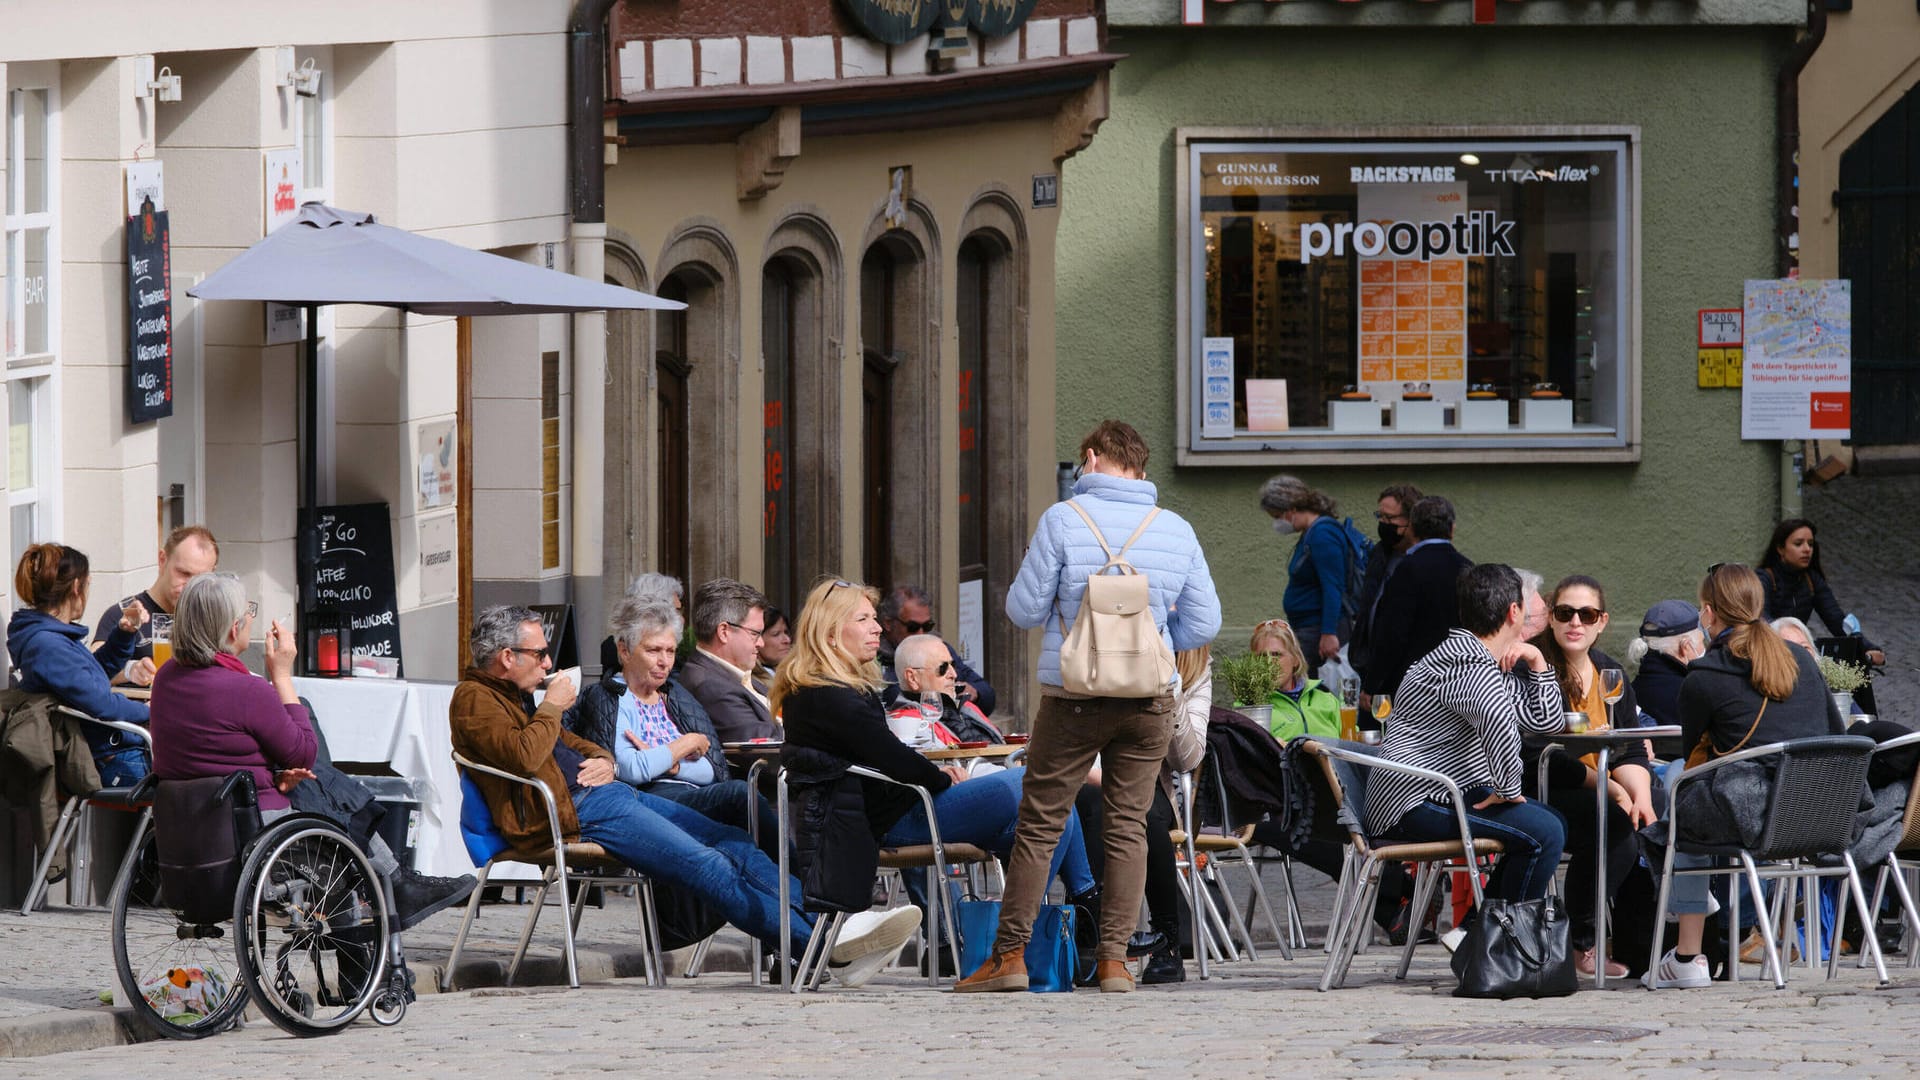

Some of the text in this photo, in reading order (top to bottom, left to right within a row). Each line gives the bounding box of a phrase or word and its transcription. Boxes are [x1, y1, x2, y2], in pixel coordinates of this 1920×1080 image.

[1217, 163, 1278, 173] GUNNAR
[1350, 166, 1455, 183] BACKSTAGE
[1222, 175, 1320, 186] GUNNARSSON
[1300, 210, 1516, 264] prooptik
[25, 276, 44, 304] BAR
[1766, 362, 1782, 370] dem
[1752, 374, 1787, 383] Tübingen
[764, 437, 783, 491] ie
[335, 522, 357, 542] GO
